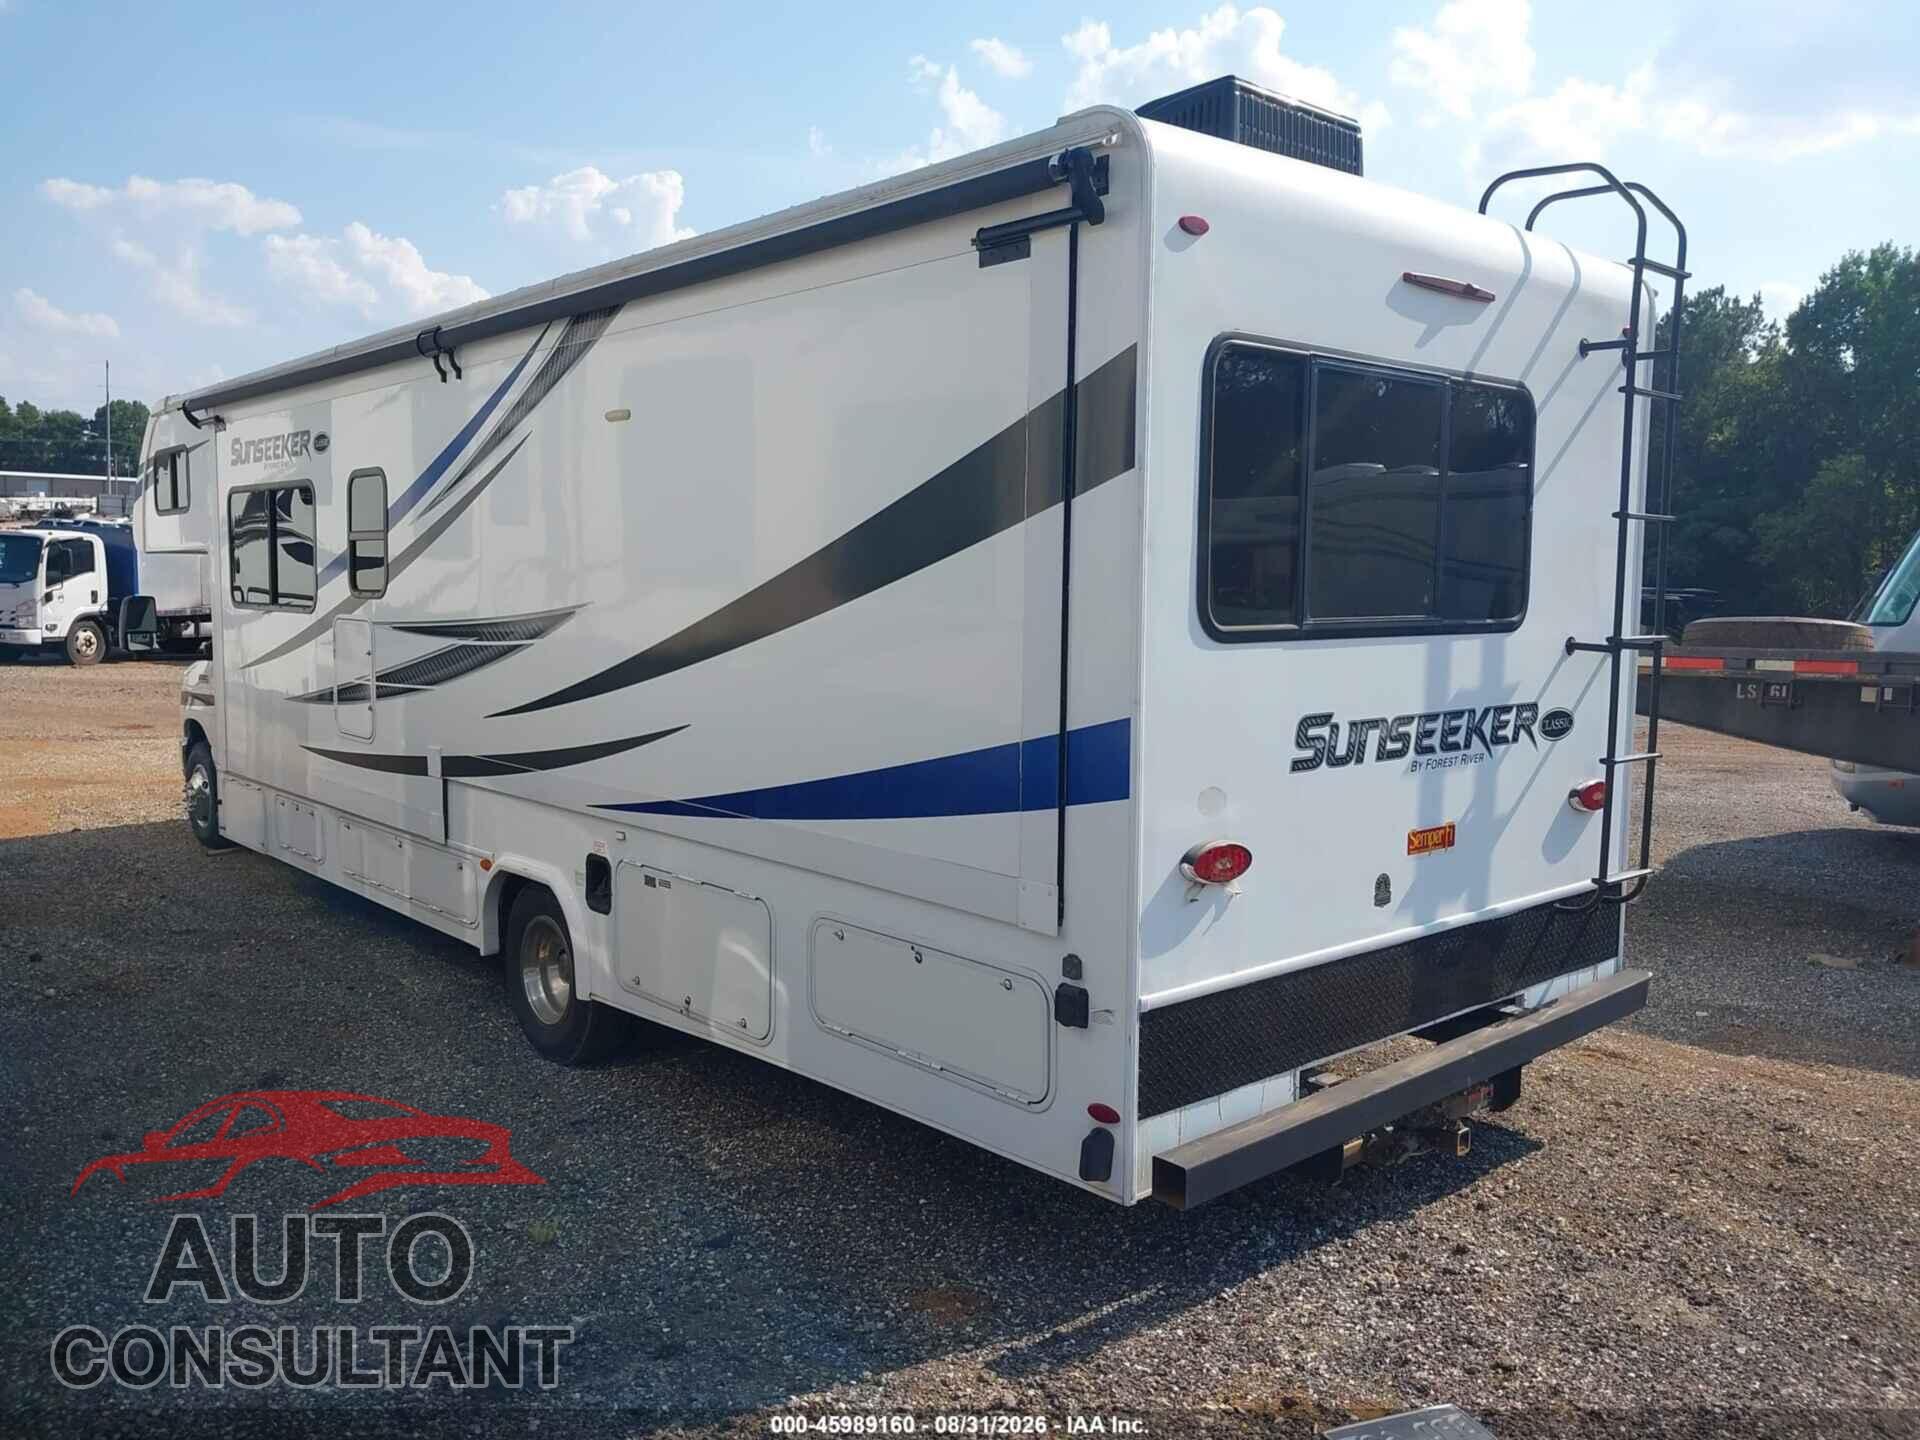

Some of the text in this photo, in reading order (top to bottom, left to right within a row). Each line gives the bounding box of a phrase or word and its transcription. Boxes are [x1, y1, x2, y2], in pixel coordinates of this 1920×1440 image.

[230, 430, 312, 467] SUNSEEKER
[1289, 702, 1540, 774] SUNSEEKER
[1410, 752, 1485, 773] BY FOREST RIVER
